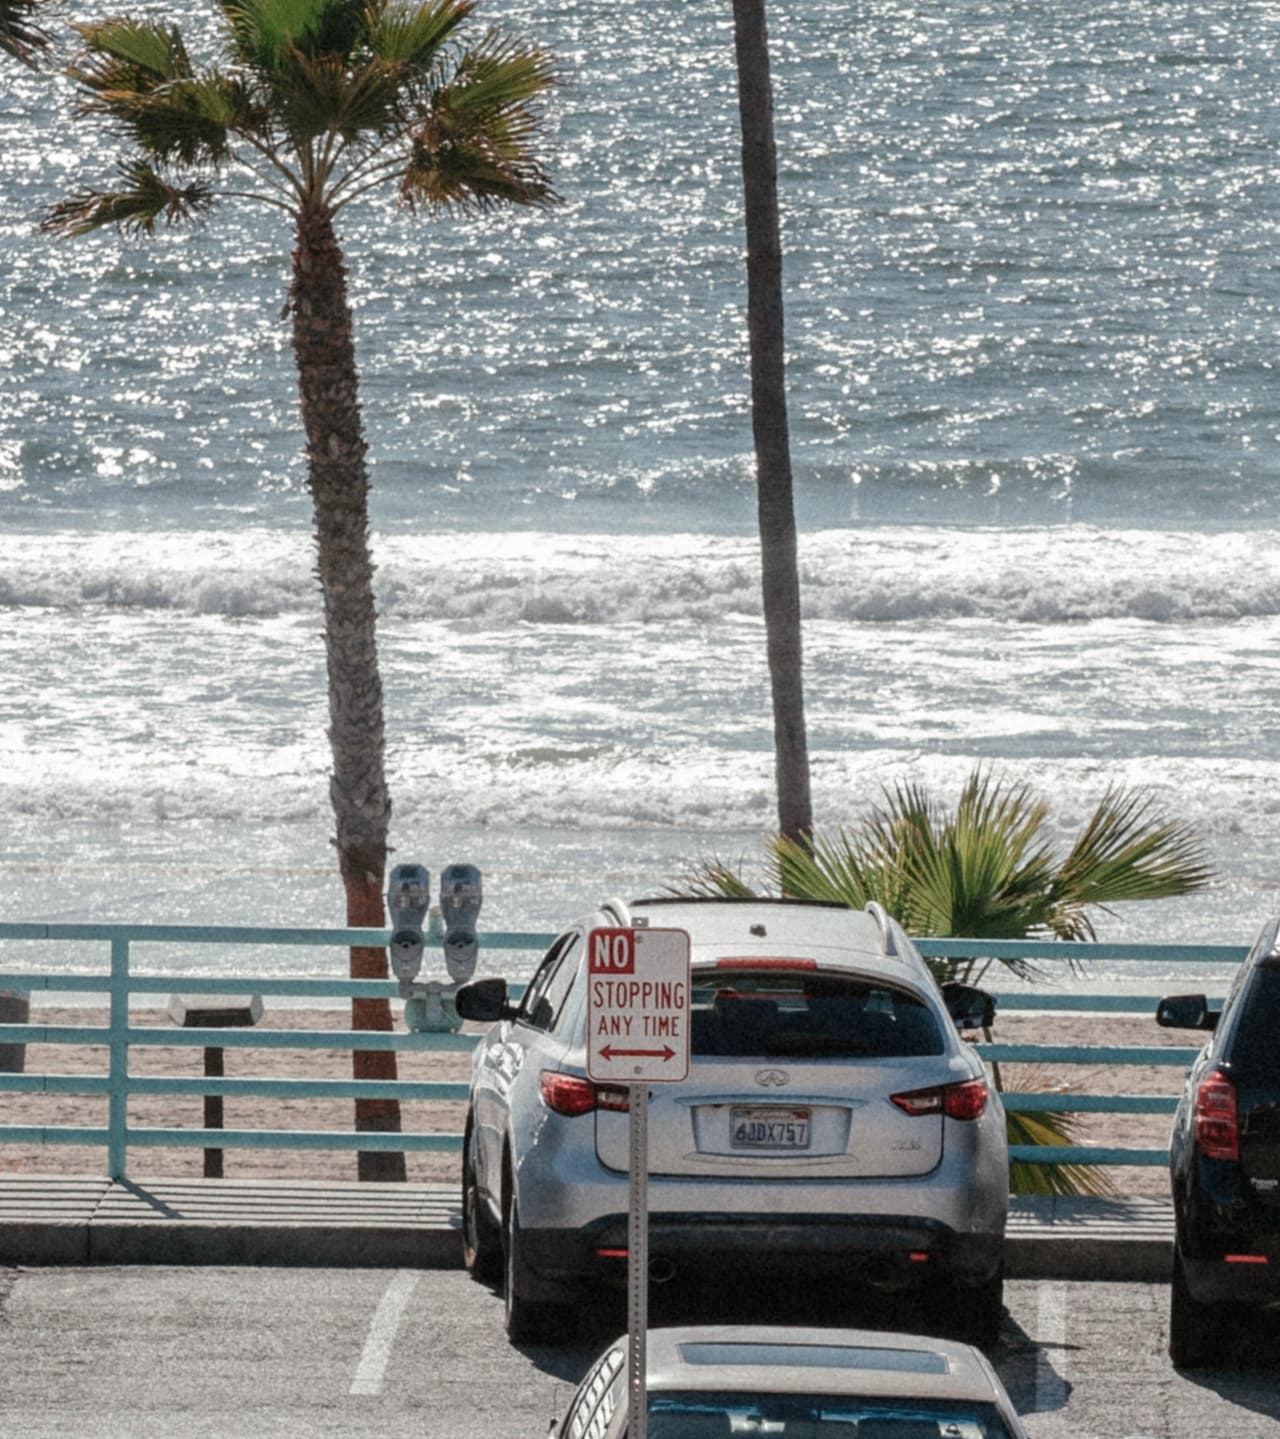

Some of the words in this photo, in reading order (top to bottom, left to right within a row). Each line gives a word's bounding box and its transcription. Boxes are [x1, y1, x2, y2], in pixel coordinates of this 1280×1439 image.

[594, 935, 629, 968] NO
[593, 981, 684, 1009] STOPPING
[597, 1016, 633, 1036] ANY
[643, 1016, 680, 1037] TIME
